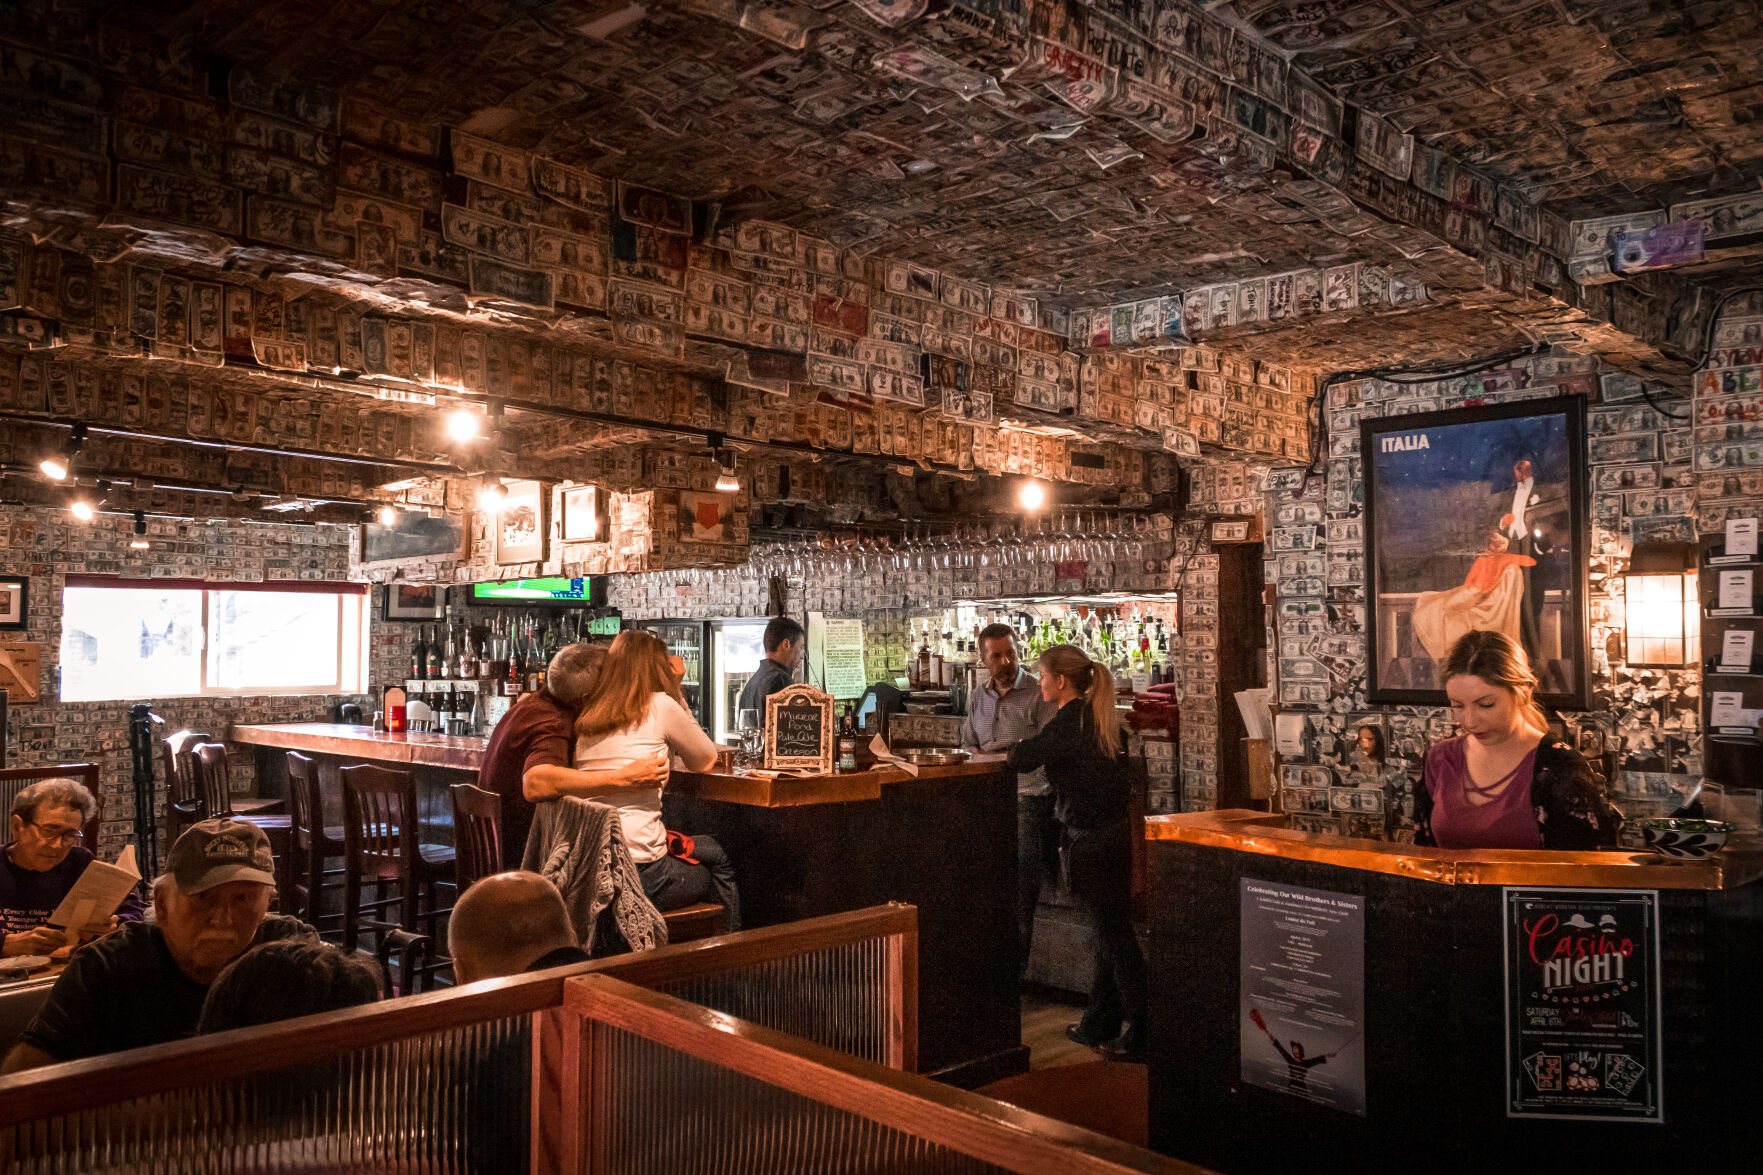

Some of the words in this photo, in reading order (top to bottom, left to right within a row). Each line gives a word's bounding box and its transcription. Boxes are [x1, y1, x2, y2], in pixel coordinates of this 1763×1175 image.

[1381, 434, 1430, 453] ITALIA
[788, 720, 813, 730] Pond
[777, 731, 794, 742] Pale
[1247, 885, 1279, 897] Celebrating
[1291, 893, 1304, 901] Wild
[1304, 895, 1330, 905] Brothers
[1337, 900, 1358, 910] Sisters
[3, 908, 25, 916] Every
[1523, 913, 1640, 966] Casino
[1543, 951, 1624, 989] NIGHT
[1526, 1007, 1561, 1017] SATURDAY
[1530, 1017, 1546, 1025] APRIL
